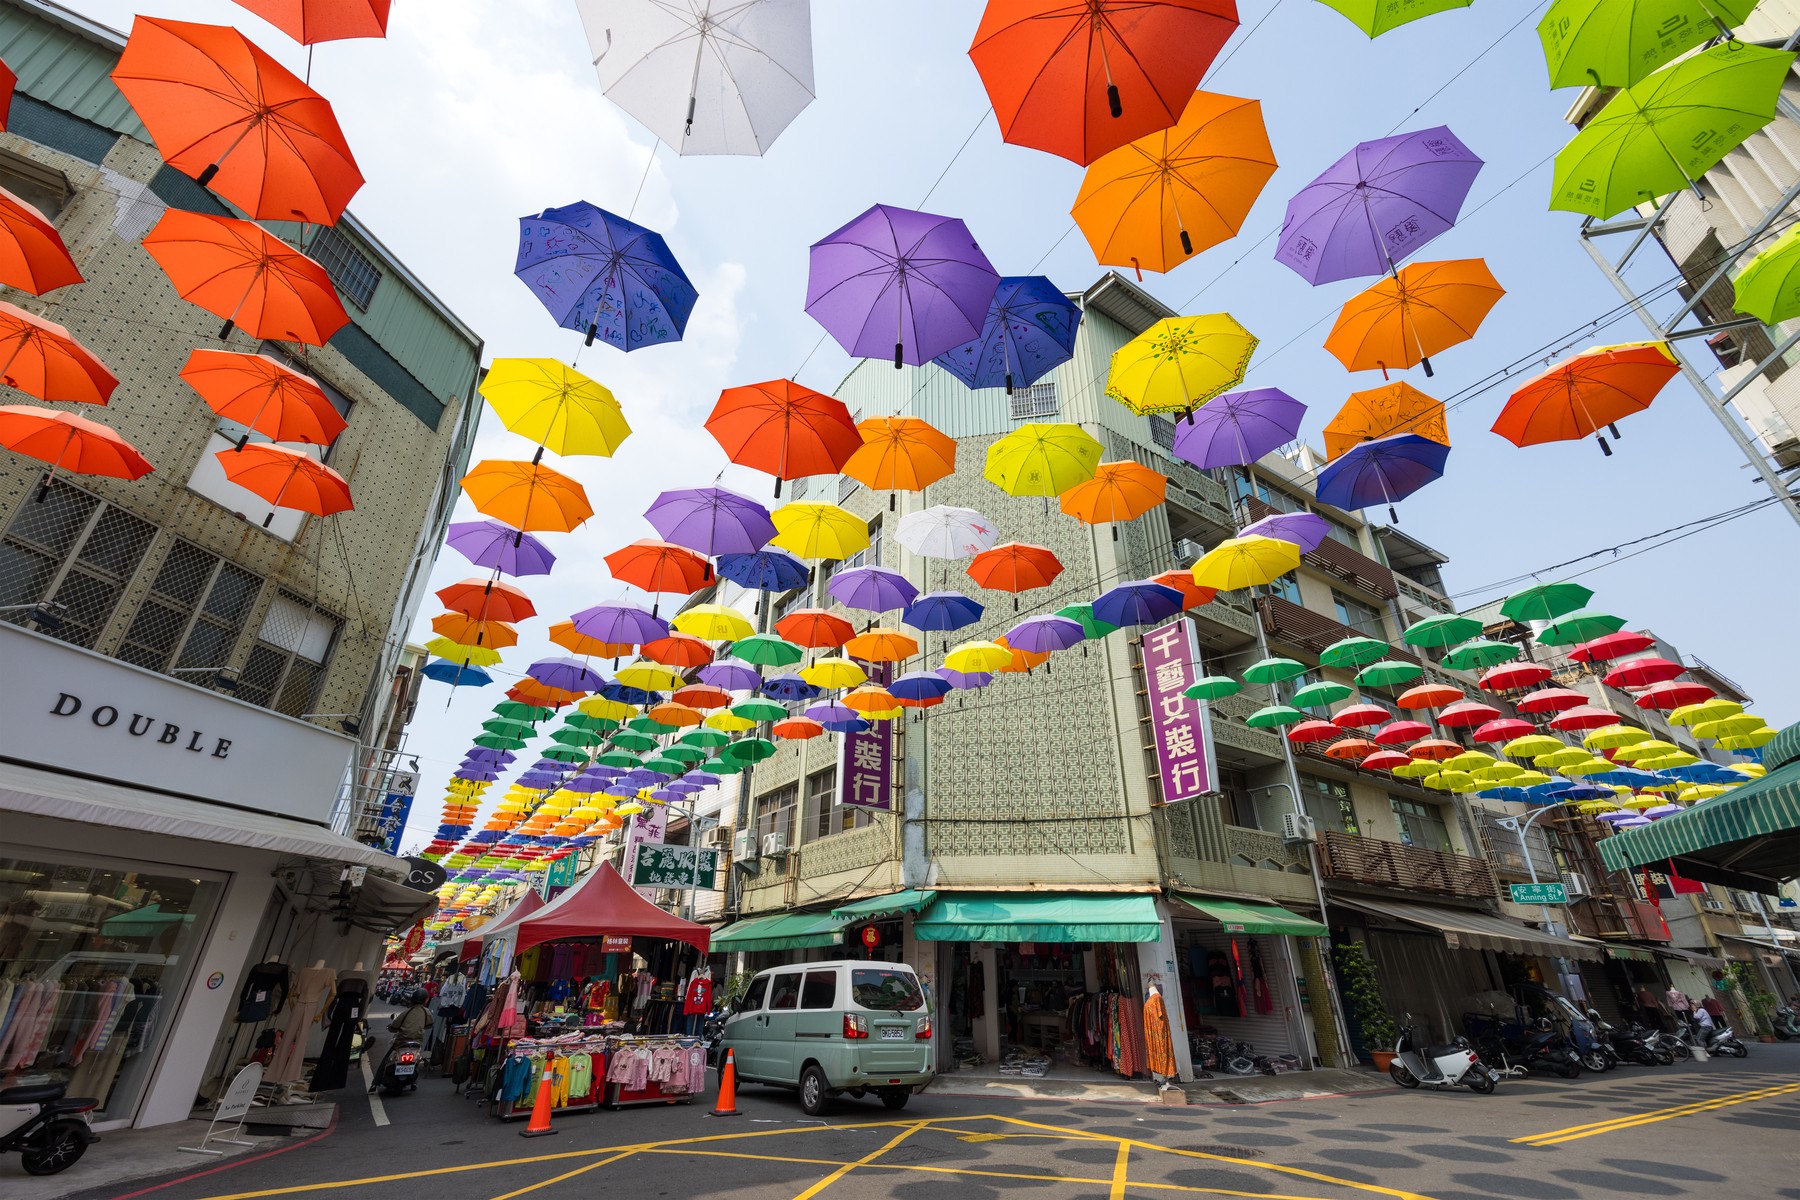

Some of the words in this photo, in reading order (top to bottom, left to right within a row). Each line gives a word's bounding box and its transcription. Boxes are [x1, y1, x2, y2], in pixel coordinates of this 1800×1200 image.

[49, 692, 233, 759] DOUBLE
[1151, 627, 1201, 795] 千藝女裝行
[1517, 885, 1556, 894] 安寧街
[1520, 894, 1547, 902] Anning
